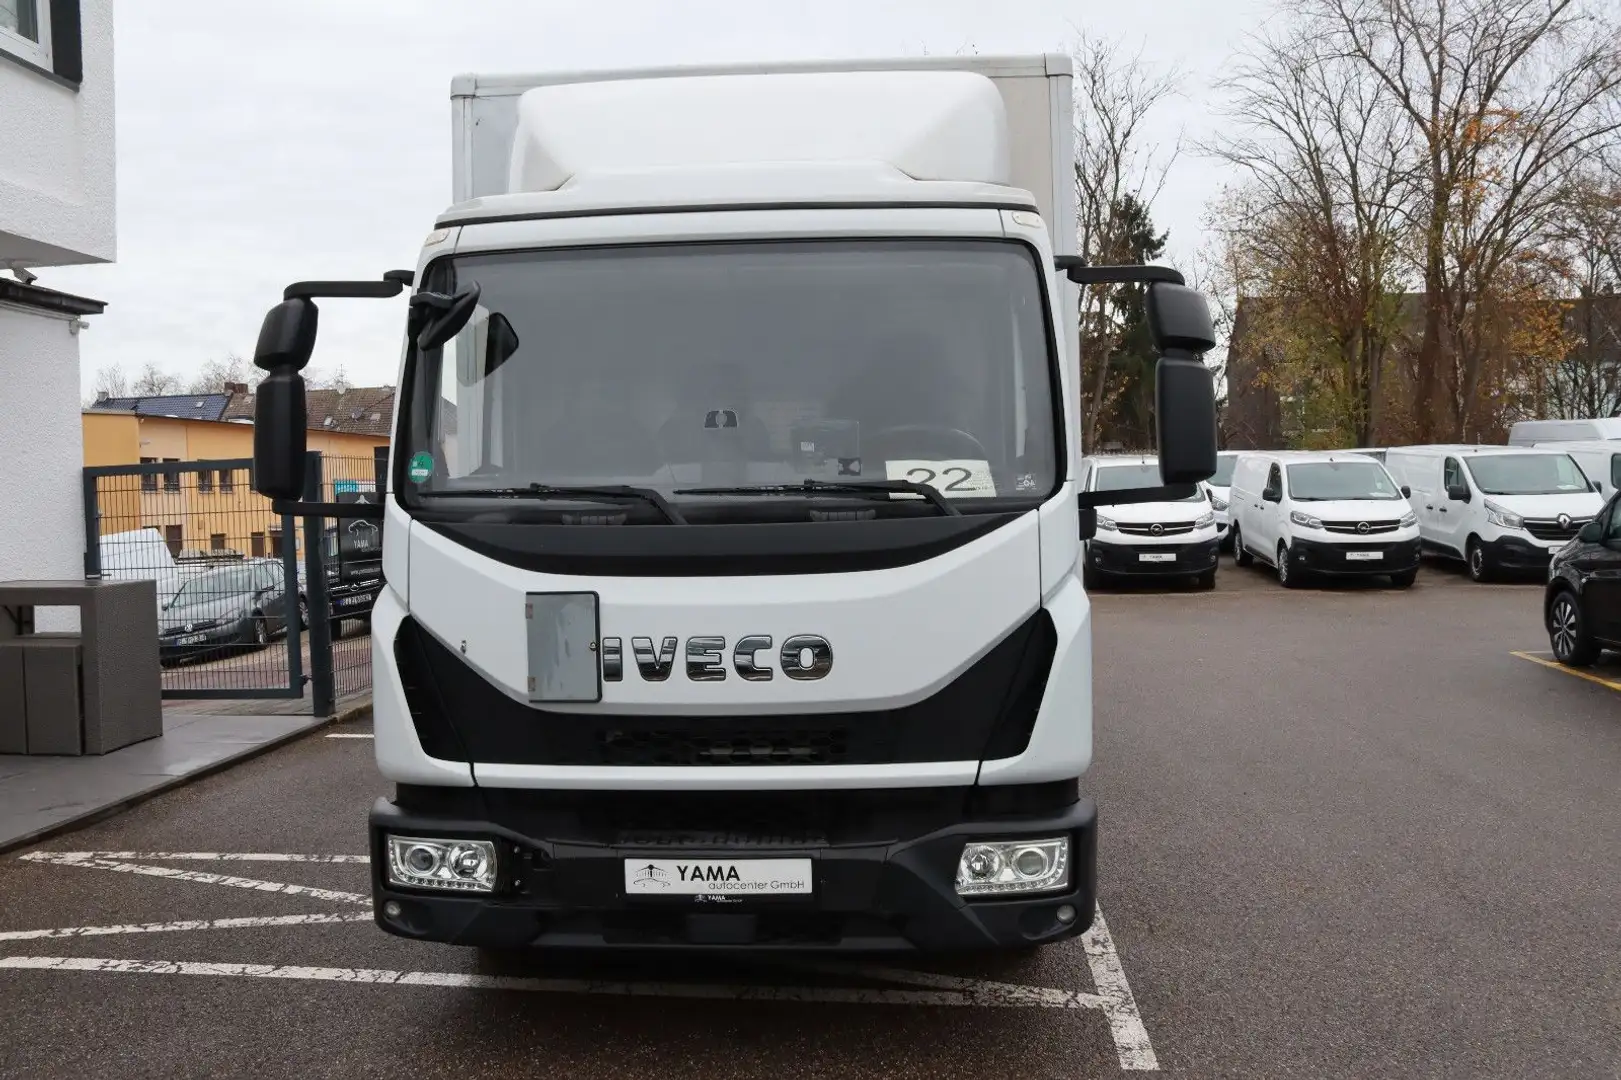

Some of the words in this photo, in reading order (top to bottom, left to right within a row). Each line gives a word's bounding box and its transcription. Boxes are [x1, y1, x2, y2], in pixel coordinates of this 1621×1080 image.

[906, 467, 975, 492] 22
[602, 634, 834, 682] IVECO
[676, 865, 741, 881] YAMA
[708, 881, 768, 890] autocenter
[770, 880, 805, 890] GmbH
